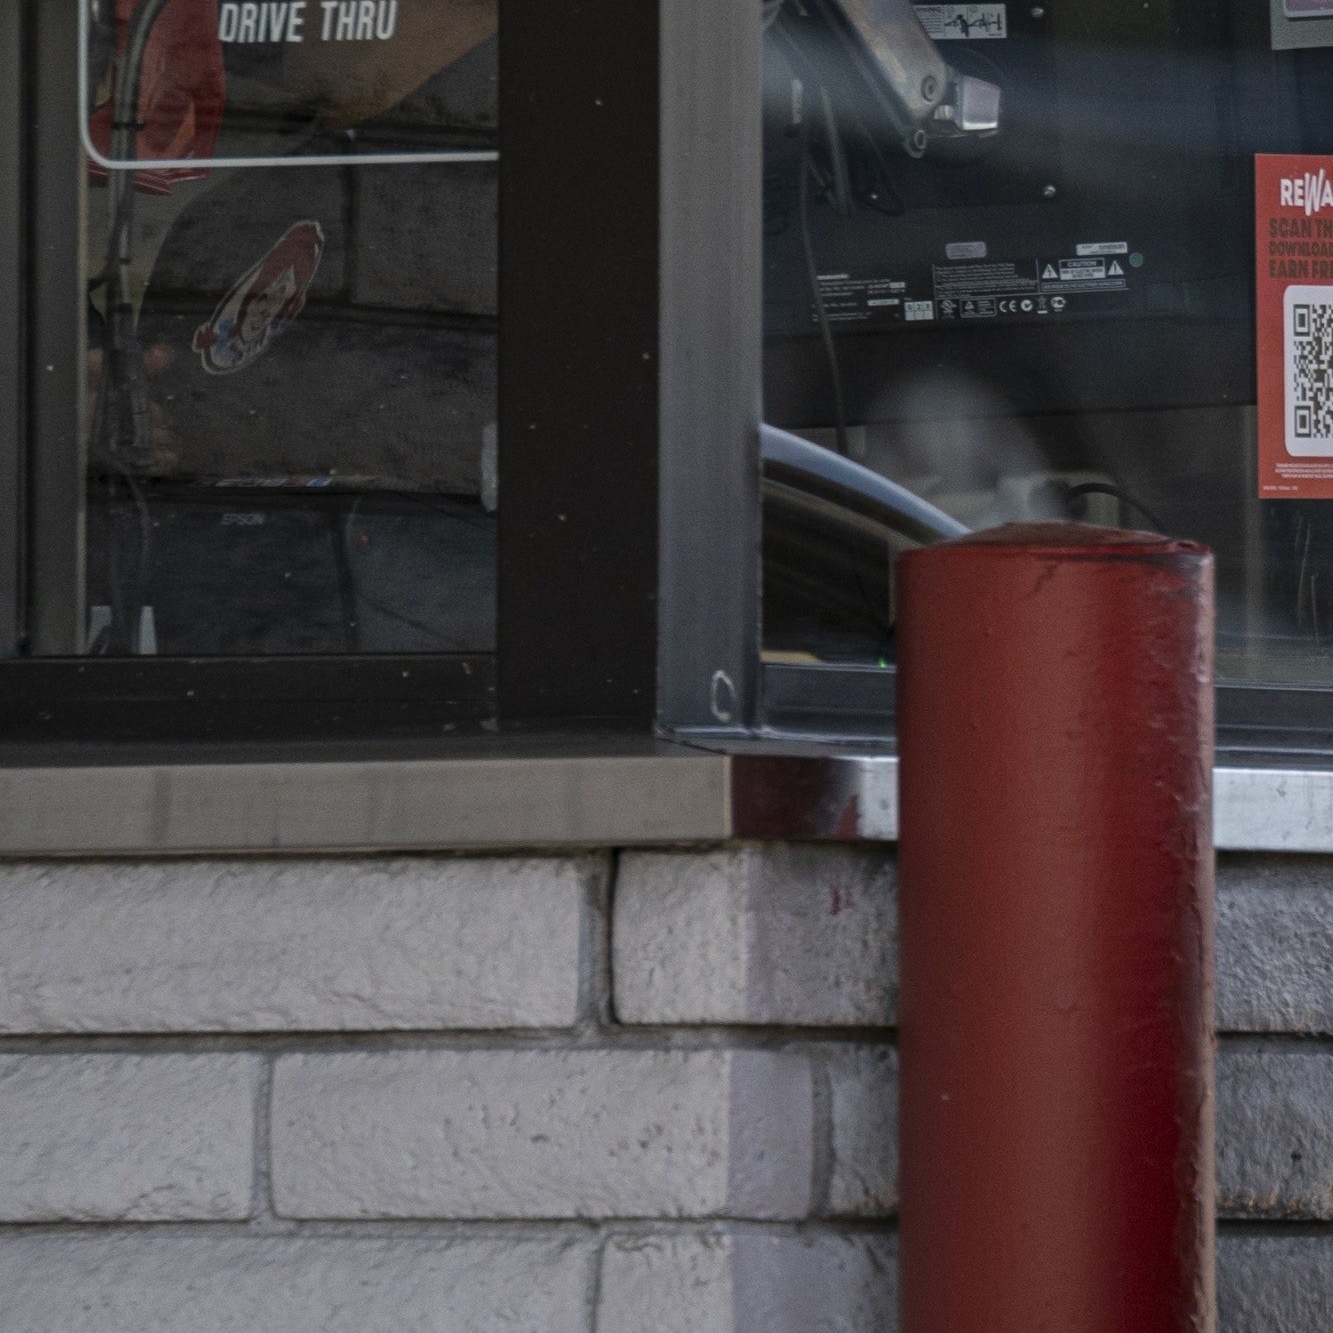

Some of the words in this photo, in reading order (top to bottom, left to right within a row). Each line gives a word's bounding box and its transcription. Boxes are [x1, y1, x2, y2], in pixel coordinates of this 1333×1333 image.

[218, 1, 306, 43] DRIVE
[320, 0, 397, 41] THRU
[1269, 218, 1312, 238] SCAN
[1269, 259, 1309, 279] EARN
